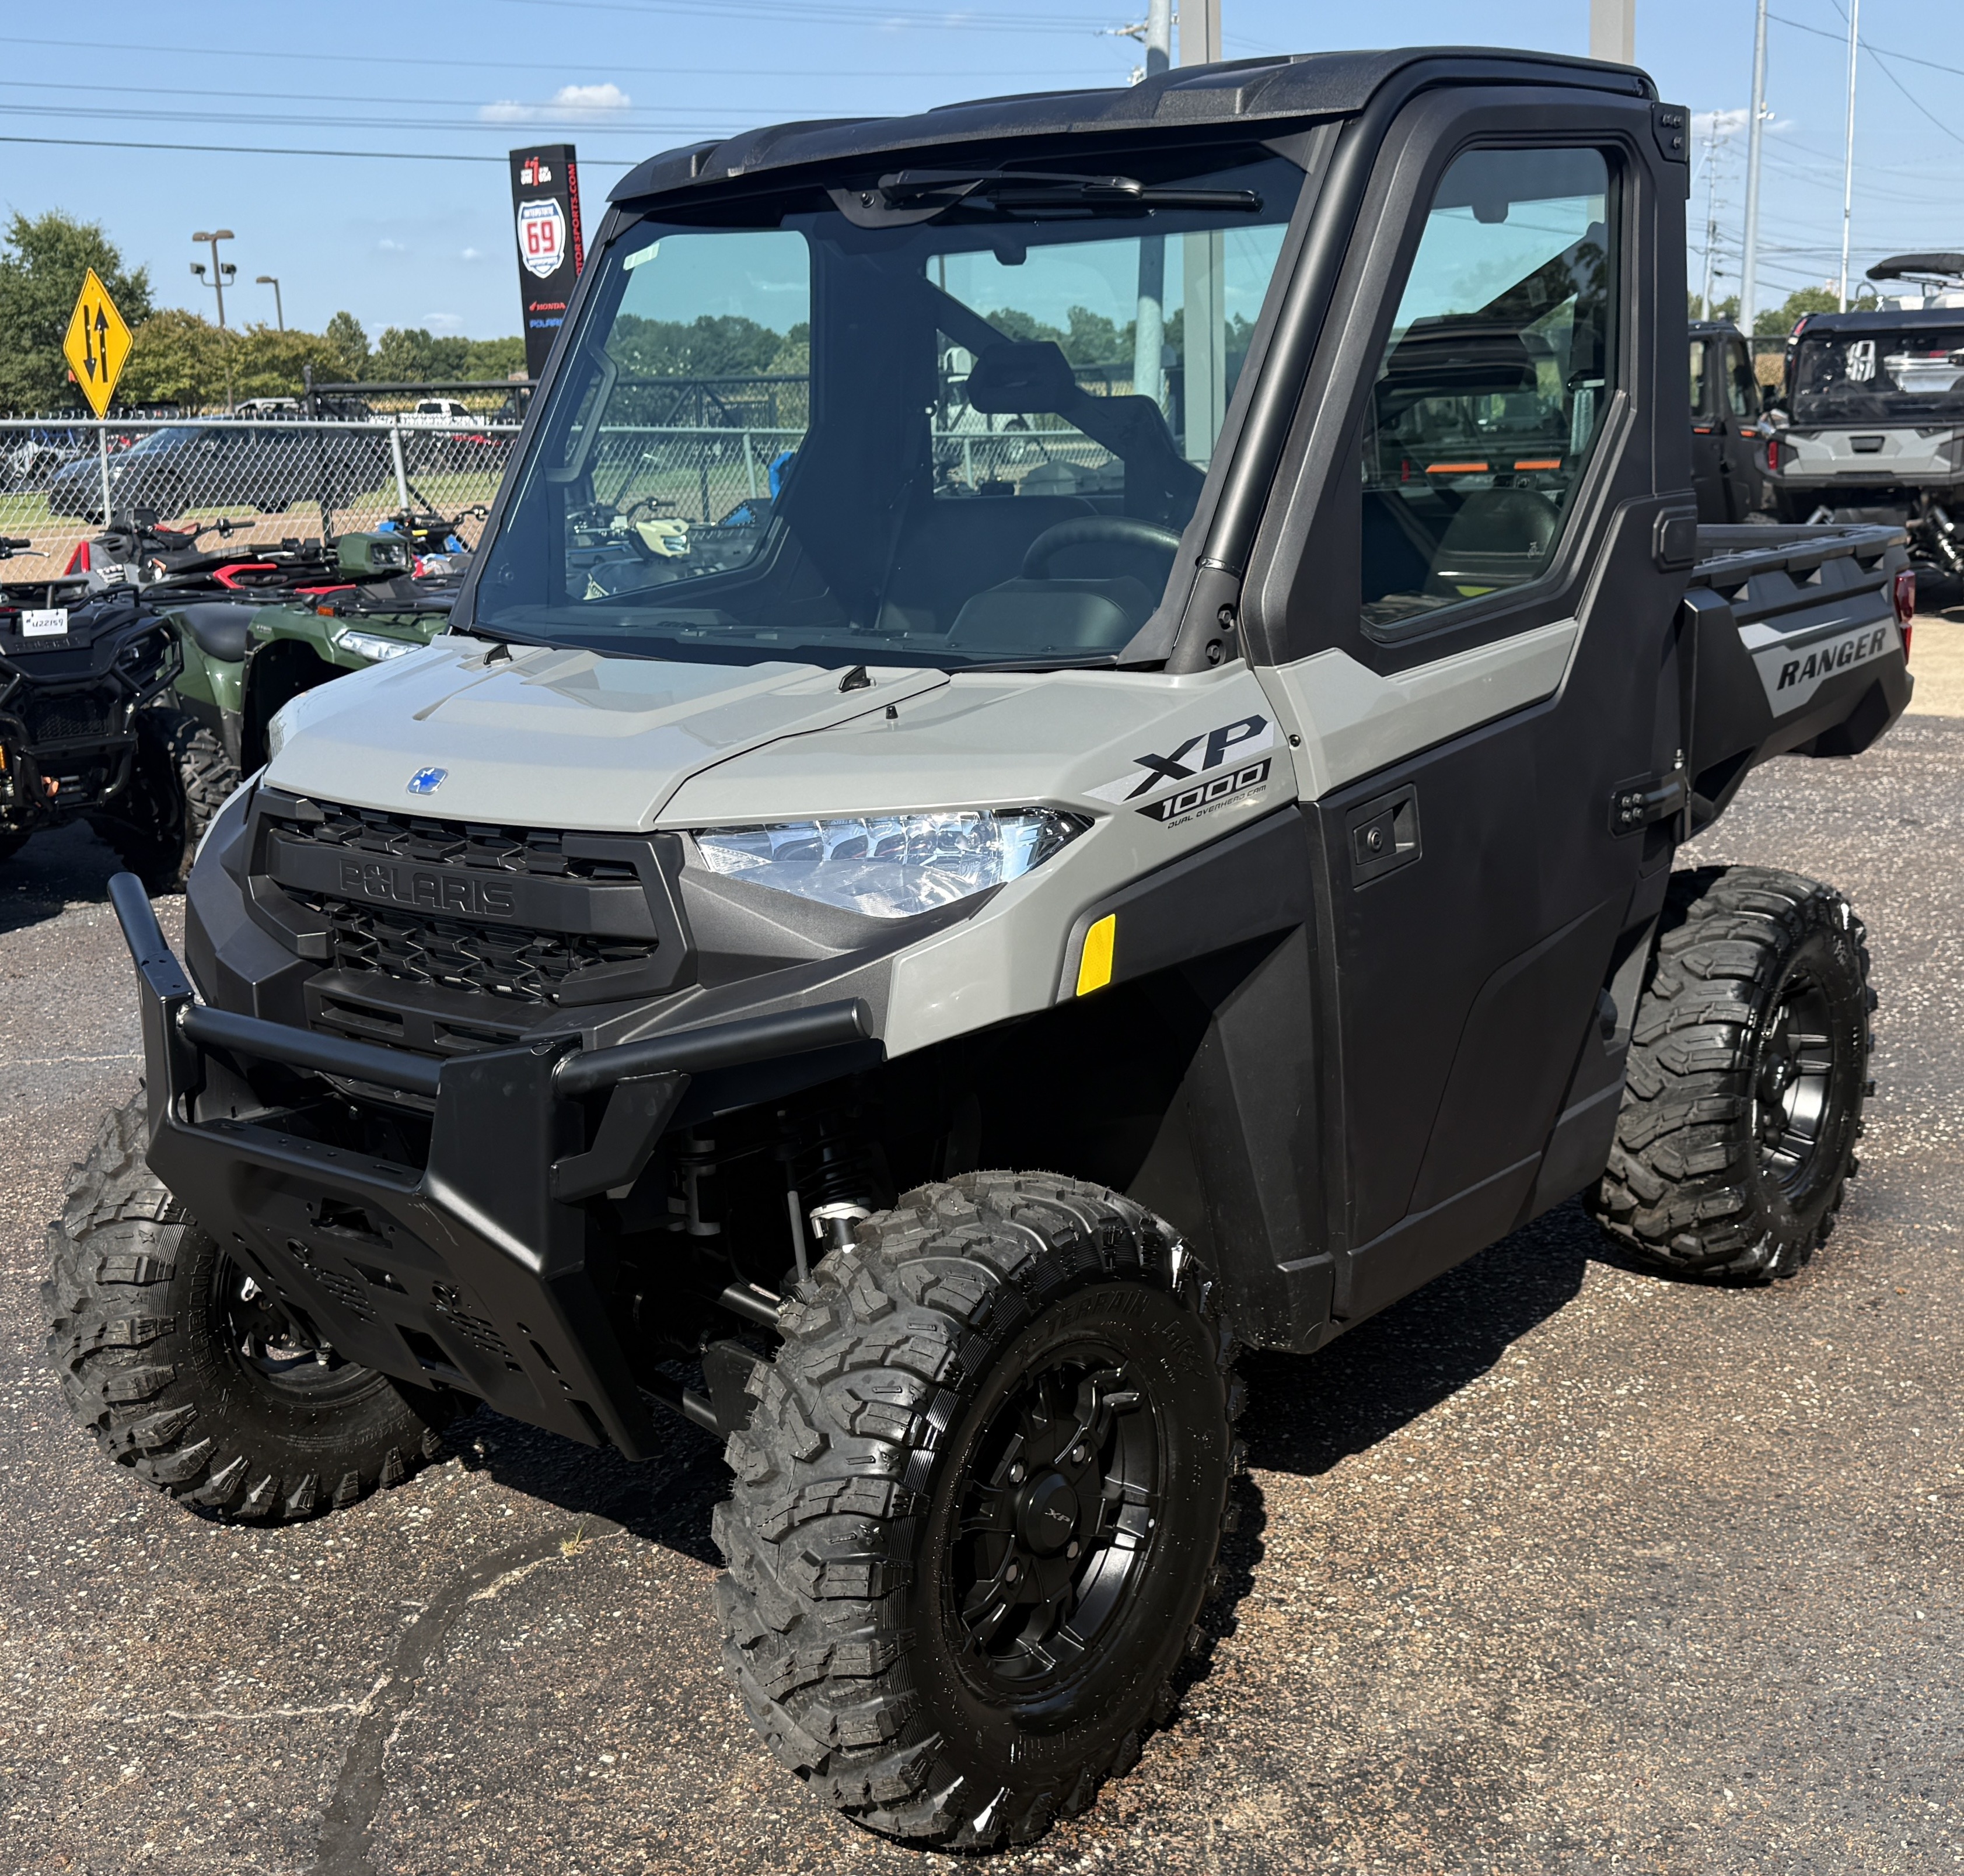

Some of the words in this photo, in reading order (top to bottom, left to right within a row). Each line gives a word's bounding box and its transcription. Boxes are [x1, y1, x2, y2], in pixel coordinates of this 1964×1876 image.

[527, 220, 555, 254] 69
[537, 302, 566, 311] HONDA
[1777, 628, 1886, 691] RANGER
[1123, 715, 1267, 802] XP
[1162, 763, 1264, 819] 1000
[1168, 815, 1193, 829] DUAL
[1196, 793, 1246, 817] OVERHEAD
[1246, 785, 1266, 797] CAM
[339, 858, 516, 918] POLARIS
[1044, 1508, 1071, 1522] XP
